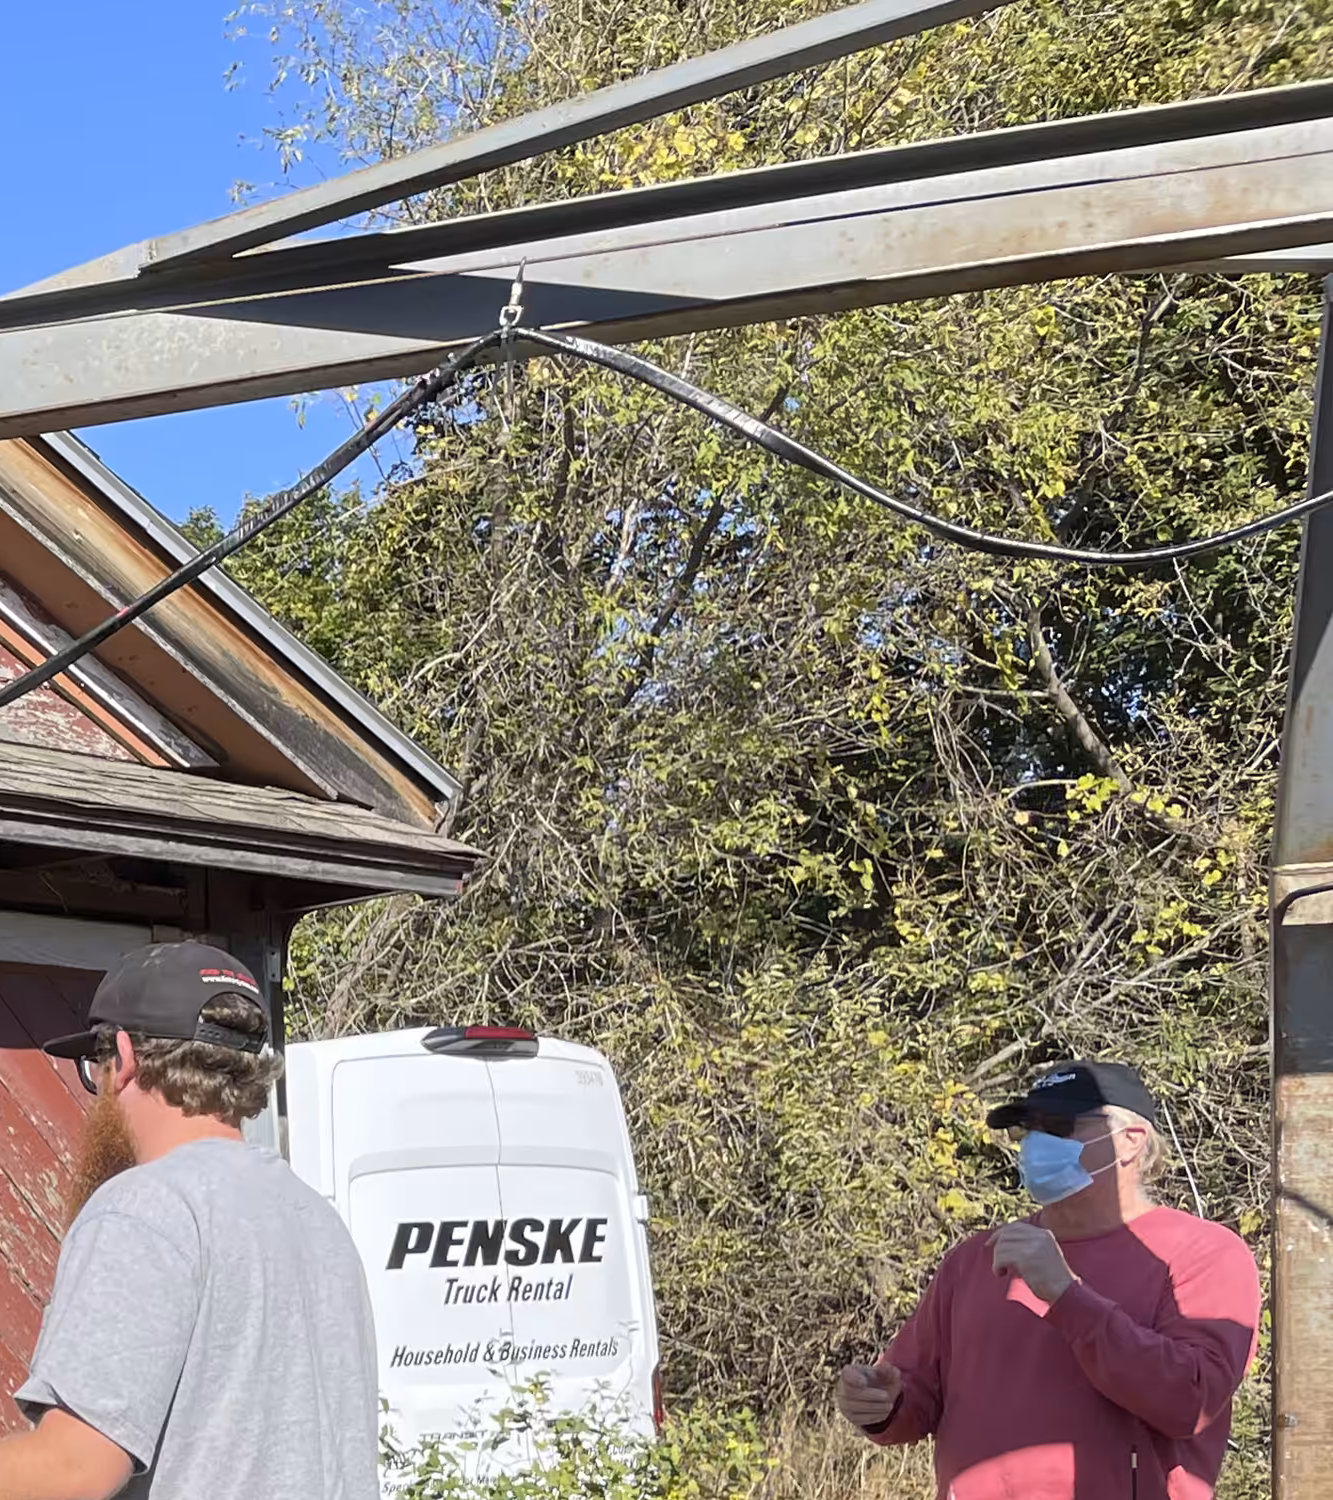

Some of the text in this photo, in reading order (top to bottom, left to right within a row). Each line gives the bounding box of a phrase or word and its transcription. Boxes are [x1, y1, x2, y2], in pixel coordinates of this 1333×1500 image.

[385, 1217, 608, 1270] PENSKE
[444, 1273, 573, 1305] Truck Rental
[390, 1336, 619, 1368] Household & Business Rentals
